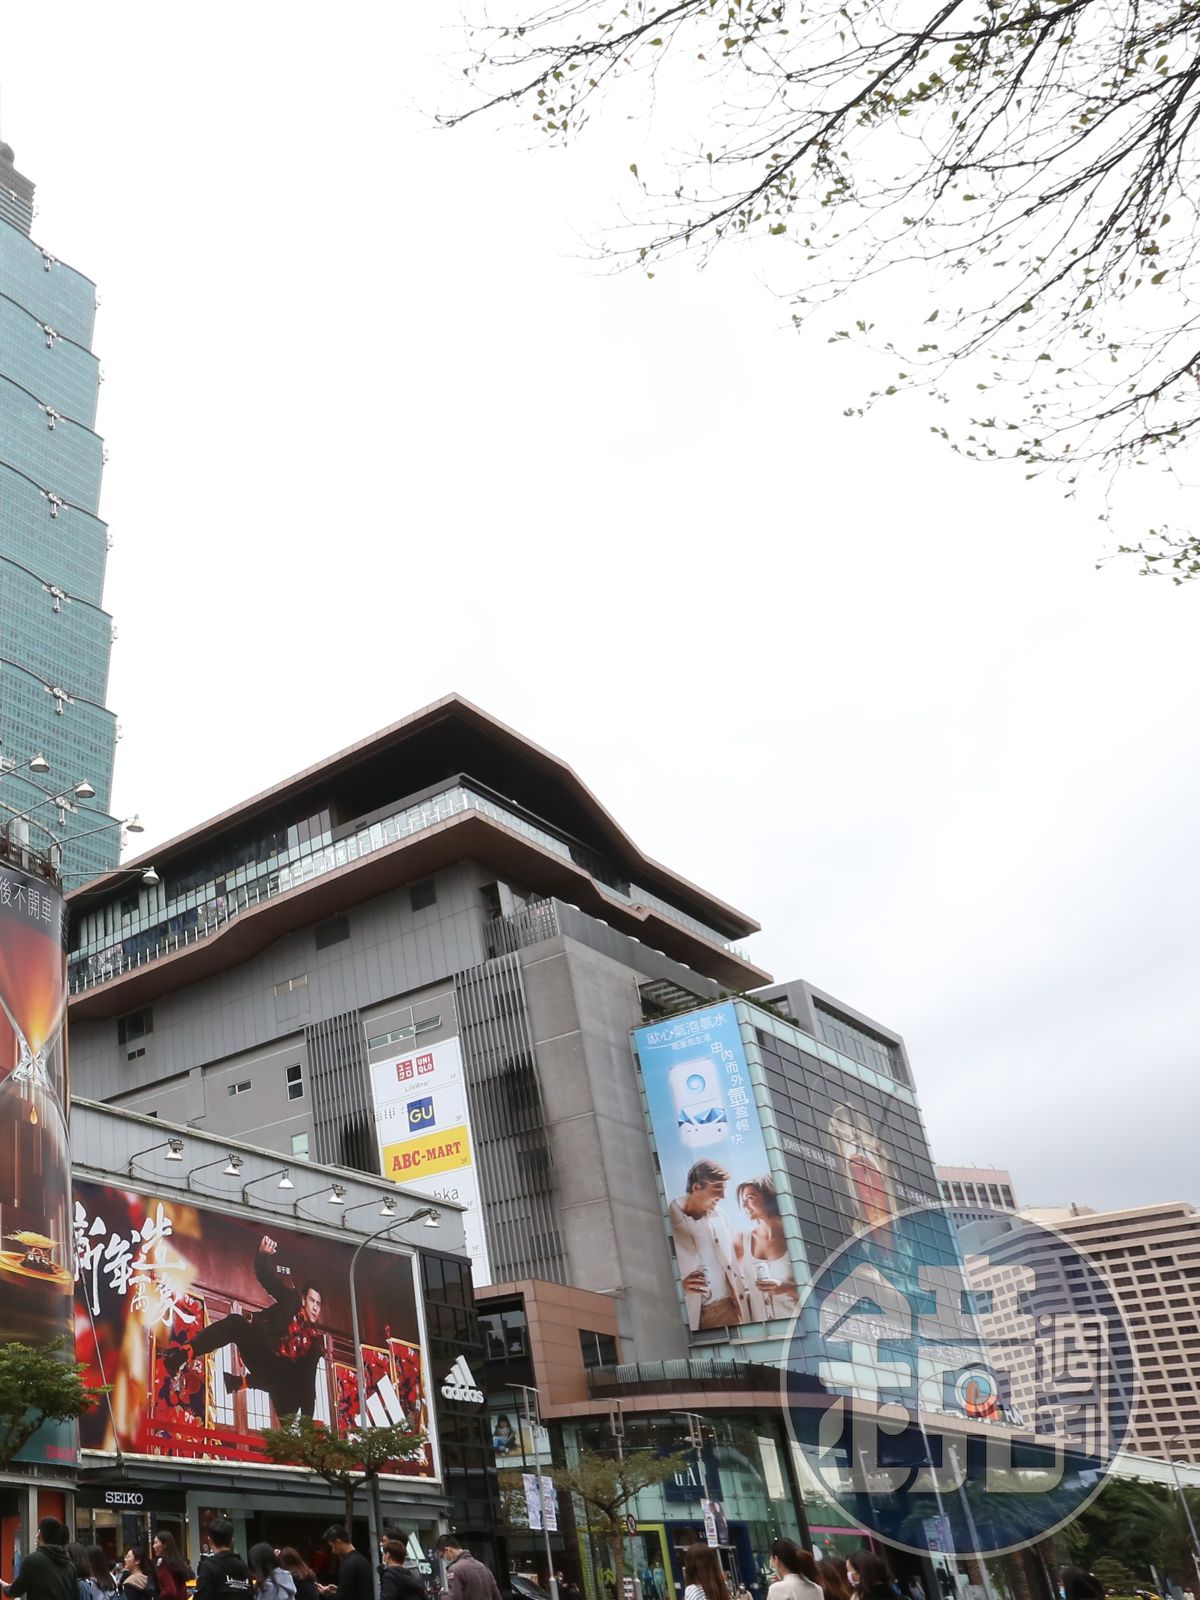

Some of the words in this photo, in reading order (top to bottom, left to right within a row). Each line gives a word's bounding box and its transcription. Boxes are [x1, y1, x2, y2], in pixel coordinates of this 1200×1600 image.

[409, 1106, 434, 1124] GU
[392, 1141, 461, 1172] ABC-MART
[441, 1383, 484, 1404] adidas
[105, 1491, 144, 1505] SEIKO
